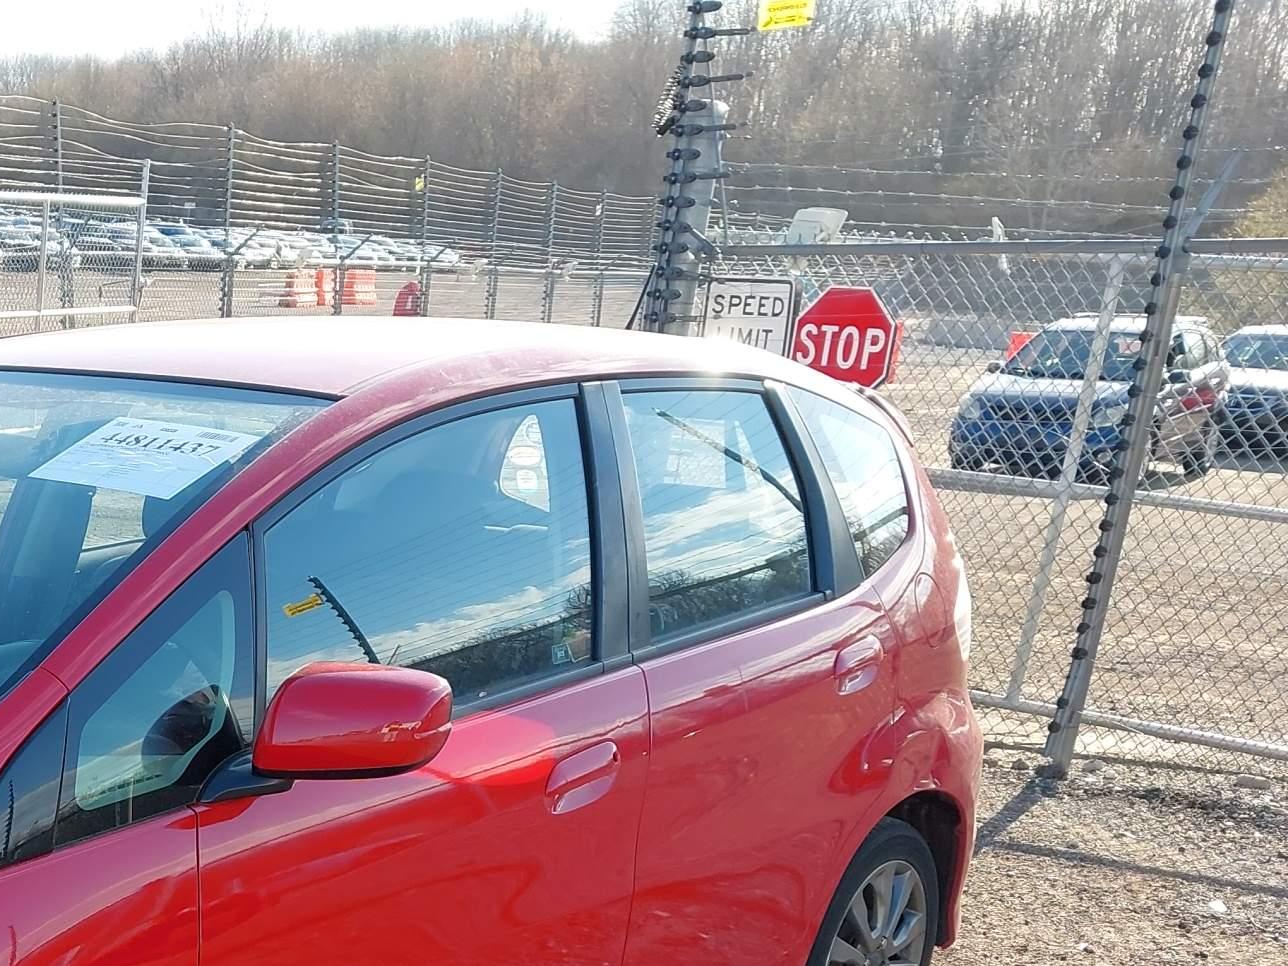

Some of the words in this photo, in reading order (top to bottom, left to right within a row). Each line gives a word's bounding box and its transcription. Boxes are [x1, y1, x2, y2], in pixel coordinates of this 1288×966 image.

[711, 294, 785, 317] SPEED
[796, 323, 886, 370] STOP
[101, 432, 222, 456] 44811437
